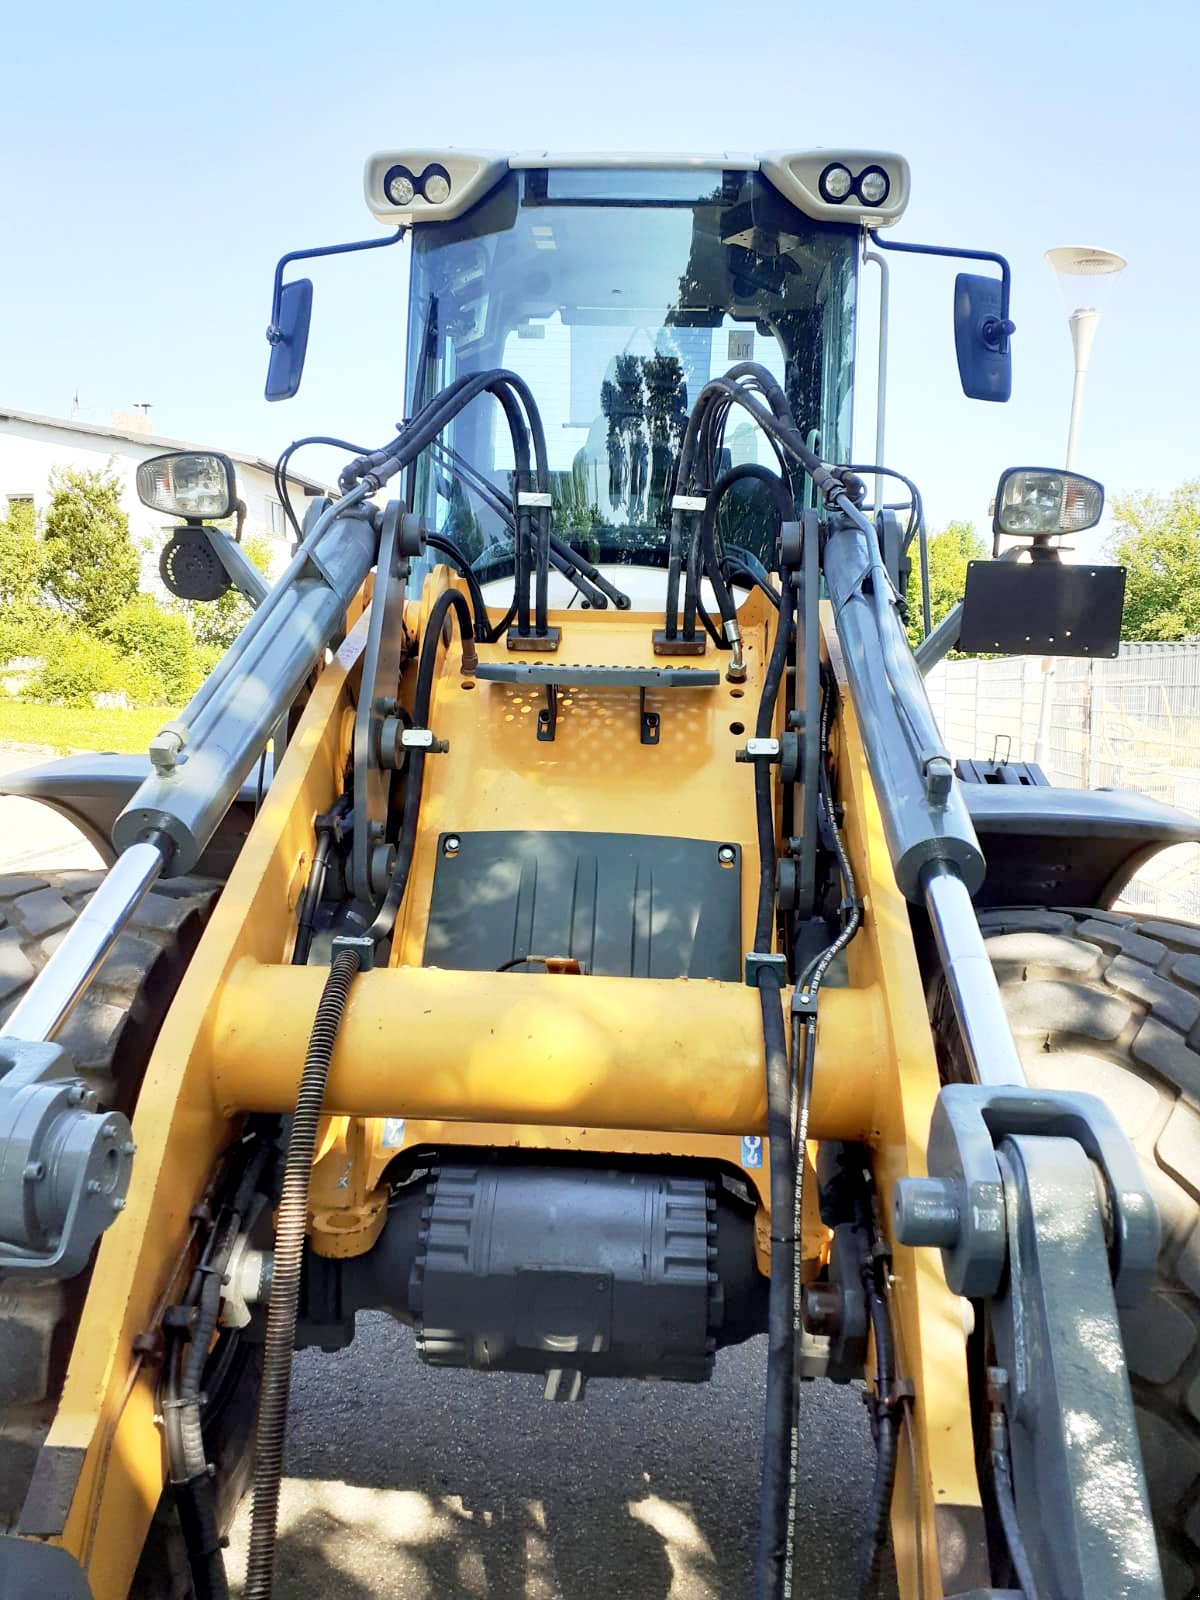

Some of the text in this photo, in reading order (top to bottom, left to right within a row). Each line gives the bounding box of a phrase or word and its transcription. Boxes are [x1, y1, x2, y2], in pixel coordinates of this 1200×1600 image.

[798, 1142, 806, 1154] WP
[795, 1186, 802, 1198] DN
[794, 1252, 801, 1265] EN
[793, 1317, 801, 1329] SH
[790, 1450, 798, 1466] 400
[790, 1467, 798, 1484] WP
[788, 1522, 796, 1536] DN
[786, 1538, 794, 1556] 1/4"
[784, 1559, 794, 1578] 2SC
